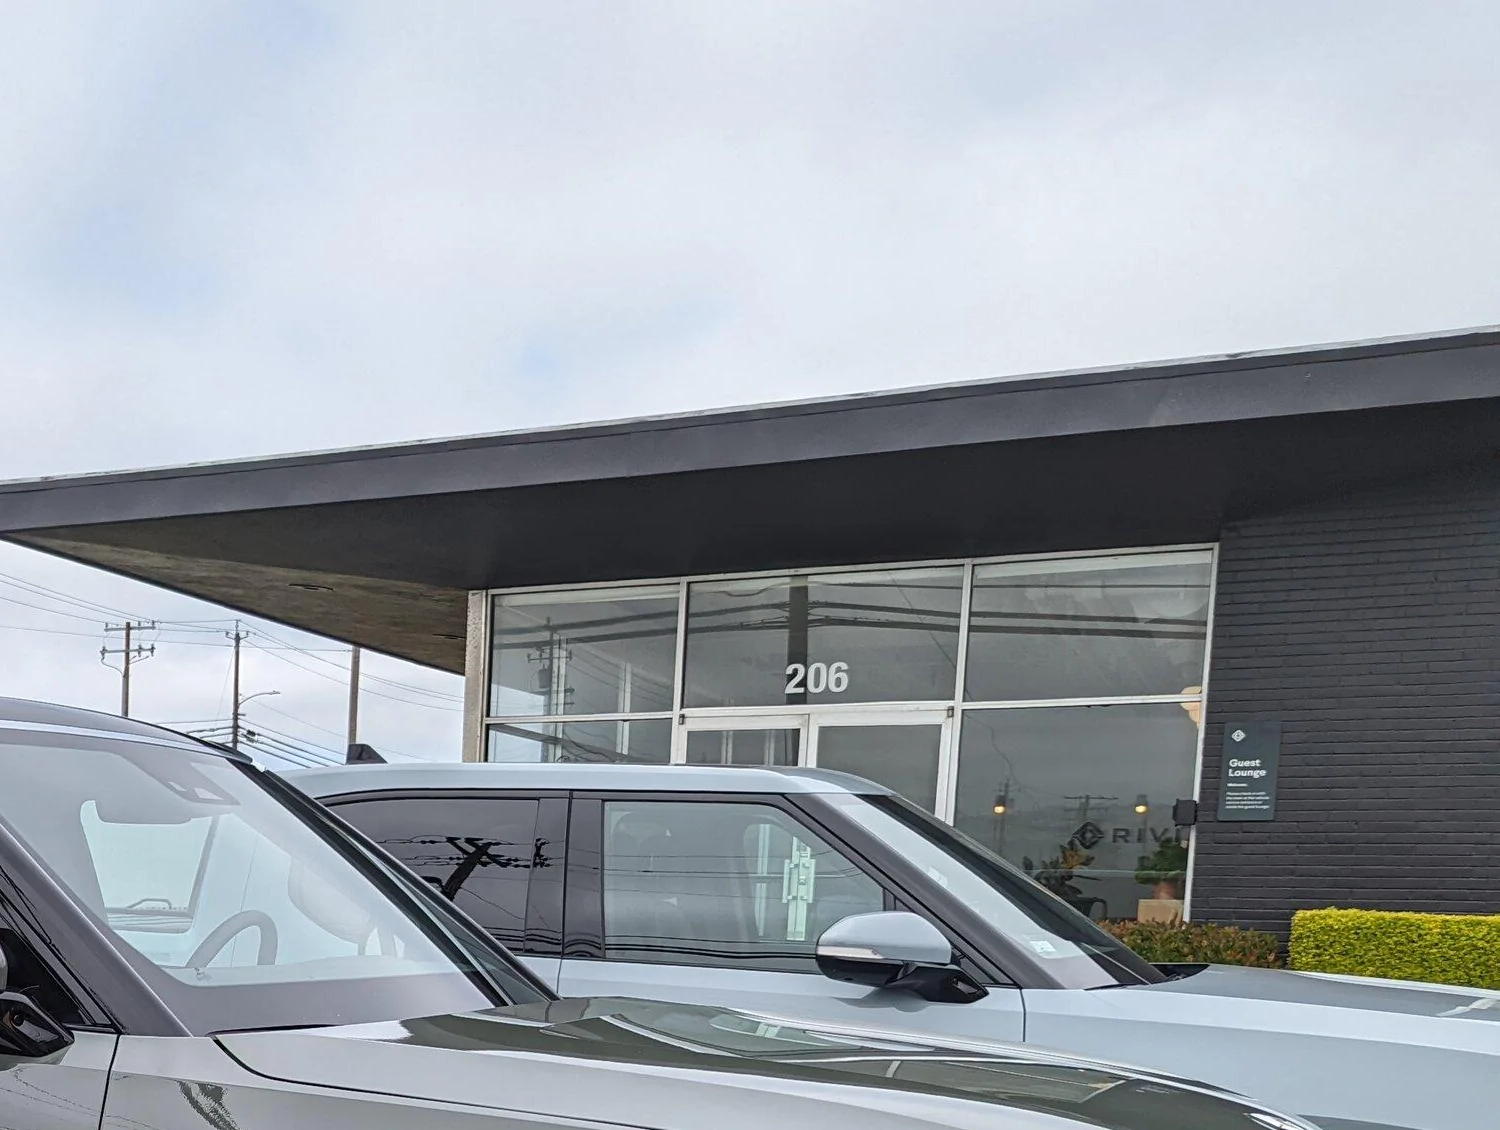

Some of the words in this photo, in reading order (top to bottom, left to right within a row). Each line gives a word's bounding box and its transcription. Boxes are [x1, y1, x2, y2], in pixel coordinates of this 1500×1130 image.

[784, 661, 850, 694] 206
[1228, 758, 1262, 768] Guest
[1228, 768, 1267, 779] Lounge
[1112, 827, 1180, 844] RIVI
